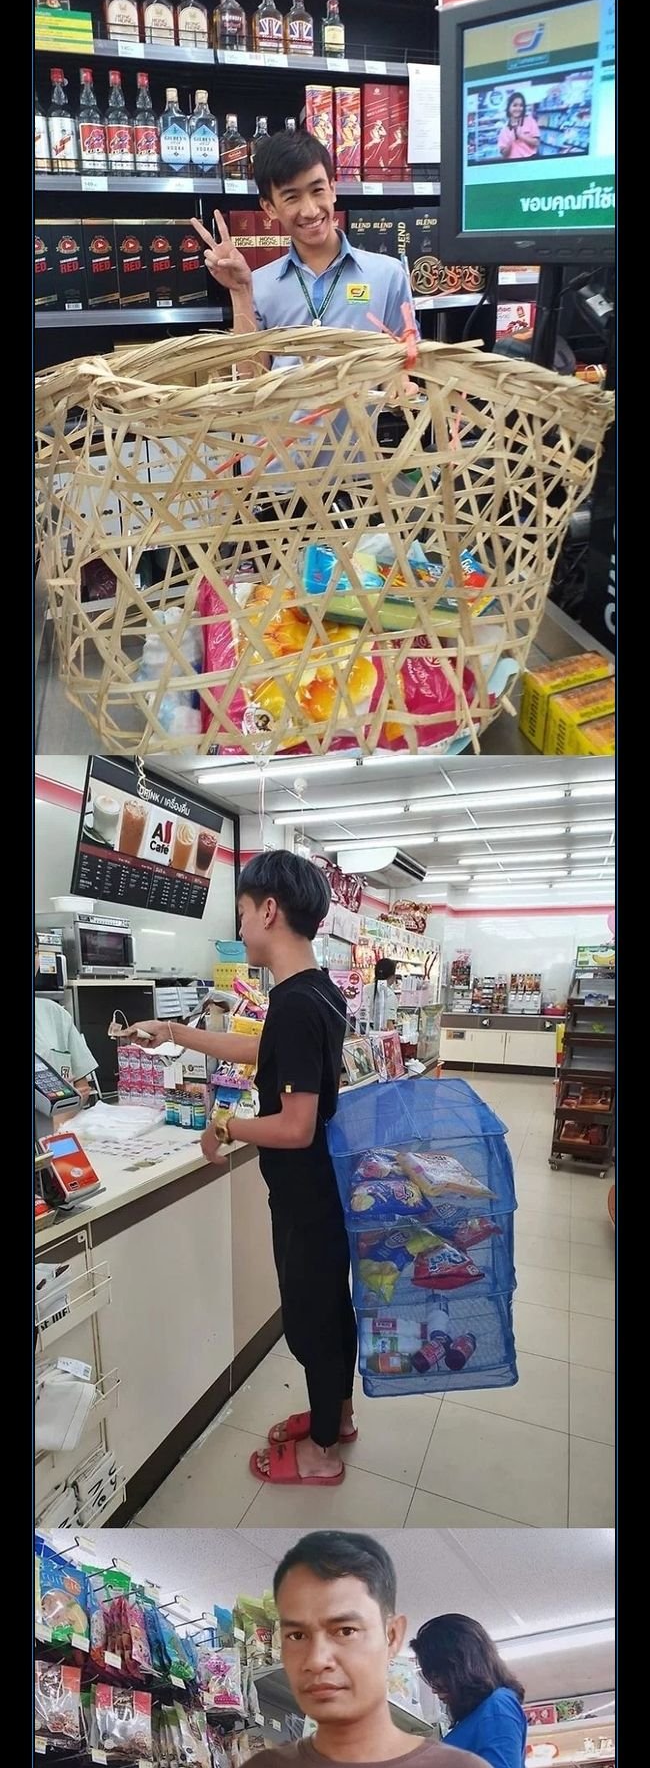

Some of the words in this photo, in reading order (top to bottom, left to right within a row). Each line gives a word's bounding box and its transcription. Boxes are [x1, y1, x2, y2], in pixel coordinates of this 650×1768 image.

[415, 218, 437, 226] BLEND
[397, 221, 406, 255] BLEND
[60, 261, 79, 274] RED
[92, 261, 111, 274] RED
[123, 261, 141, 273] RED
[153, 260, 170, 272] RED
[182, 260, 199, 273] RED
[139, 785, 160, 802] DRINK
[152, 820, 173, 844] All
[150, 840, 170, 855] Café
